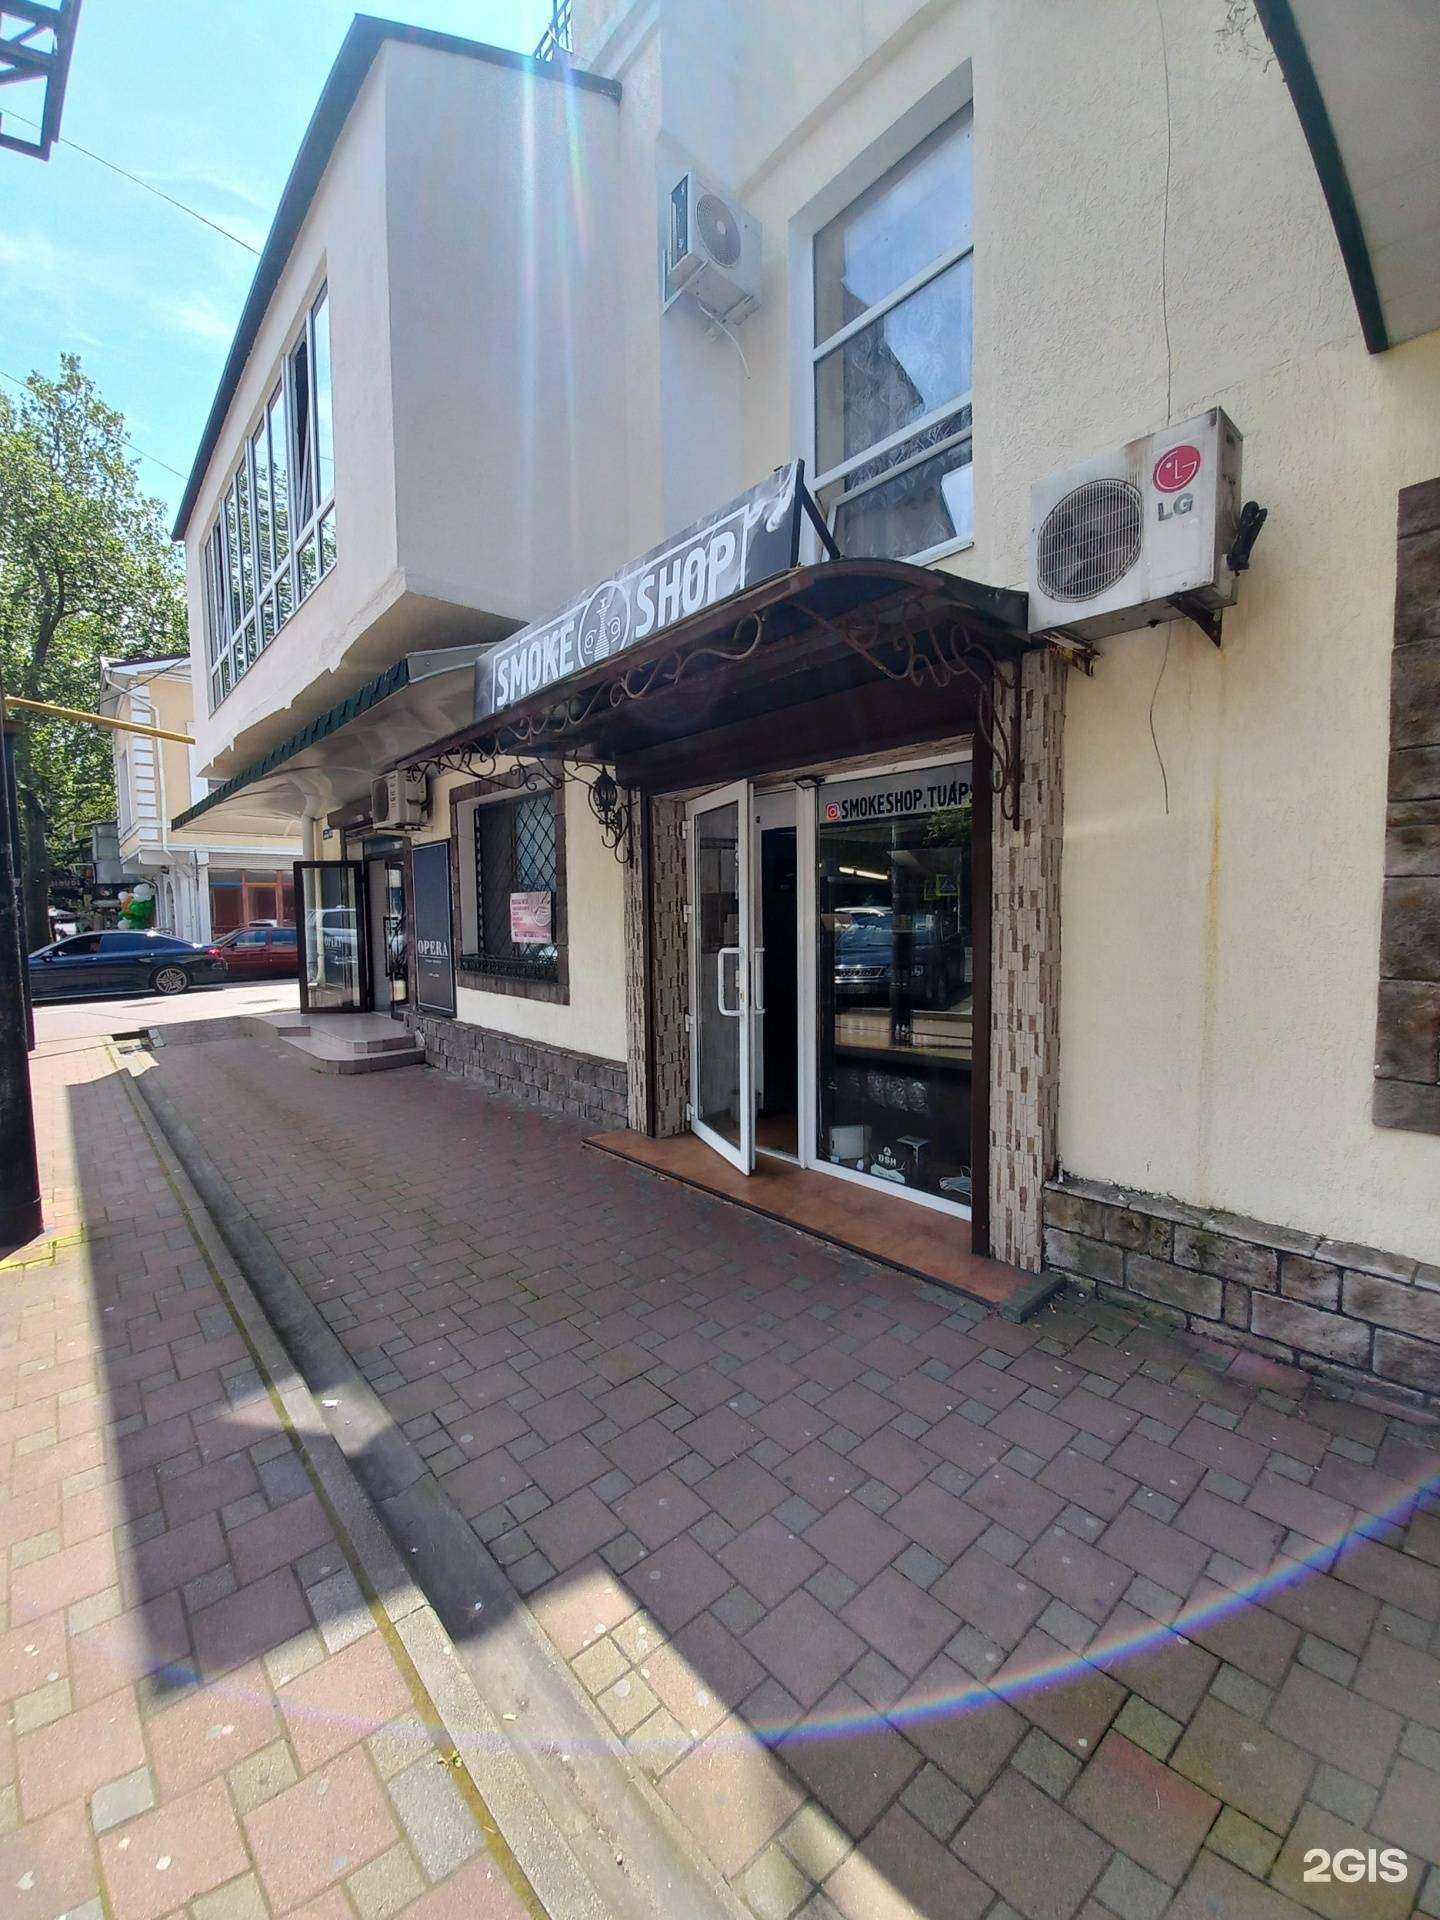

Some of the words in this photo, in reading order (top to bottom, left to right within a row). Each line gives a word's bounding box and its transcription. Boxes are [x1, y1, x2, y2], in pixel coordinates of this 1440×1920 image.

[1157, 493, 1194, 521] LG
[496, 618, 575, 706] SMOKE
[634, 530, 736, 638] SHOP
[417, 939, 448, 956] OPERA
